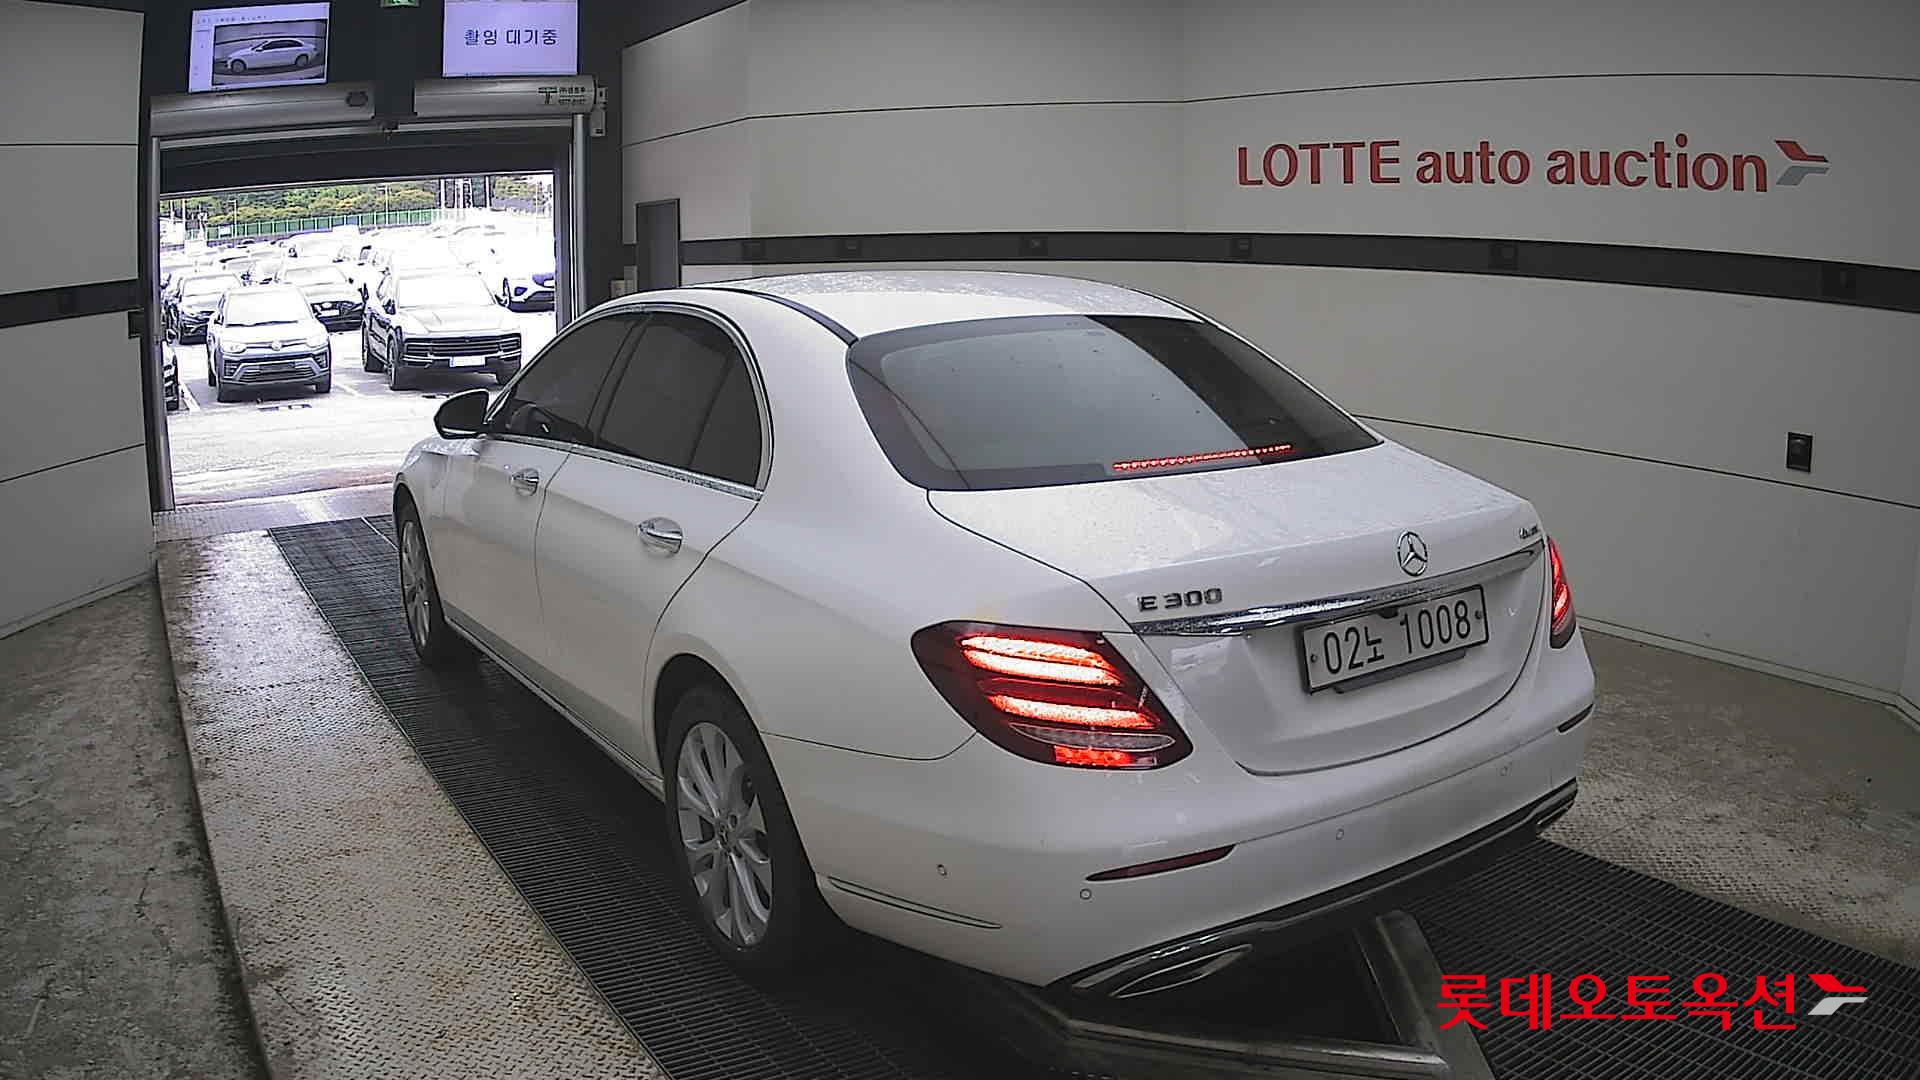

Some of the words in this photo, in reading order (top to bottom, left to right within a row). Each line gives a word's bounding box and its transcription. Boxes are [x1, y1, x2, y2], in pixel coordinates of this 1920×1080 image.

[506, 29, 558, 46] 대기중
[1237, 139, 1401, 187] LOTTE
[1415, 140, 1531, 186] auto
[1546, 133, 1769, 193] auction
[1136, 595, 1158, 613] E
[1163, 587, 1224, 608] 300
[1323, 626, 1386, 676] 02노
[1399, 599, 1472, 656] 1008
